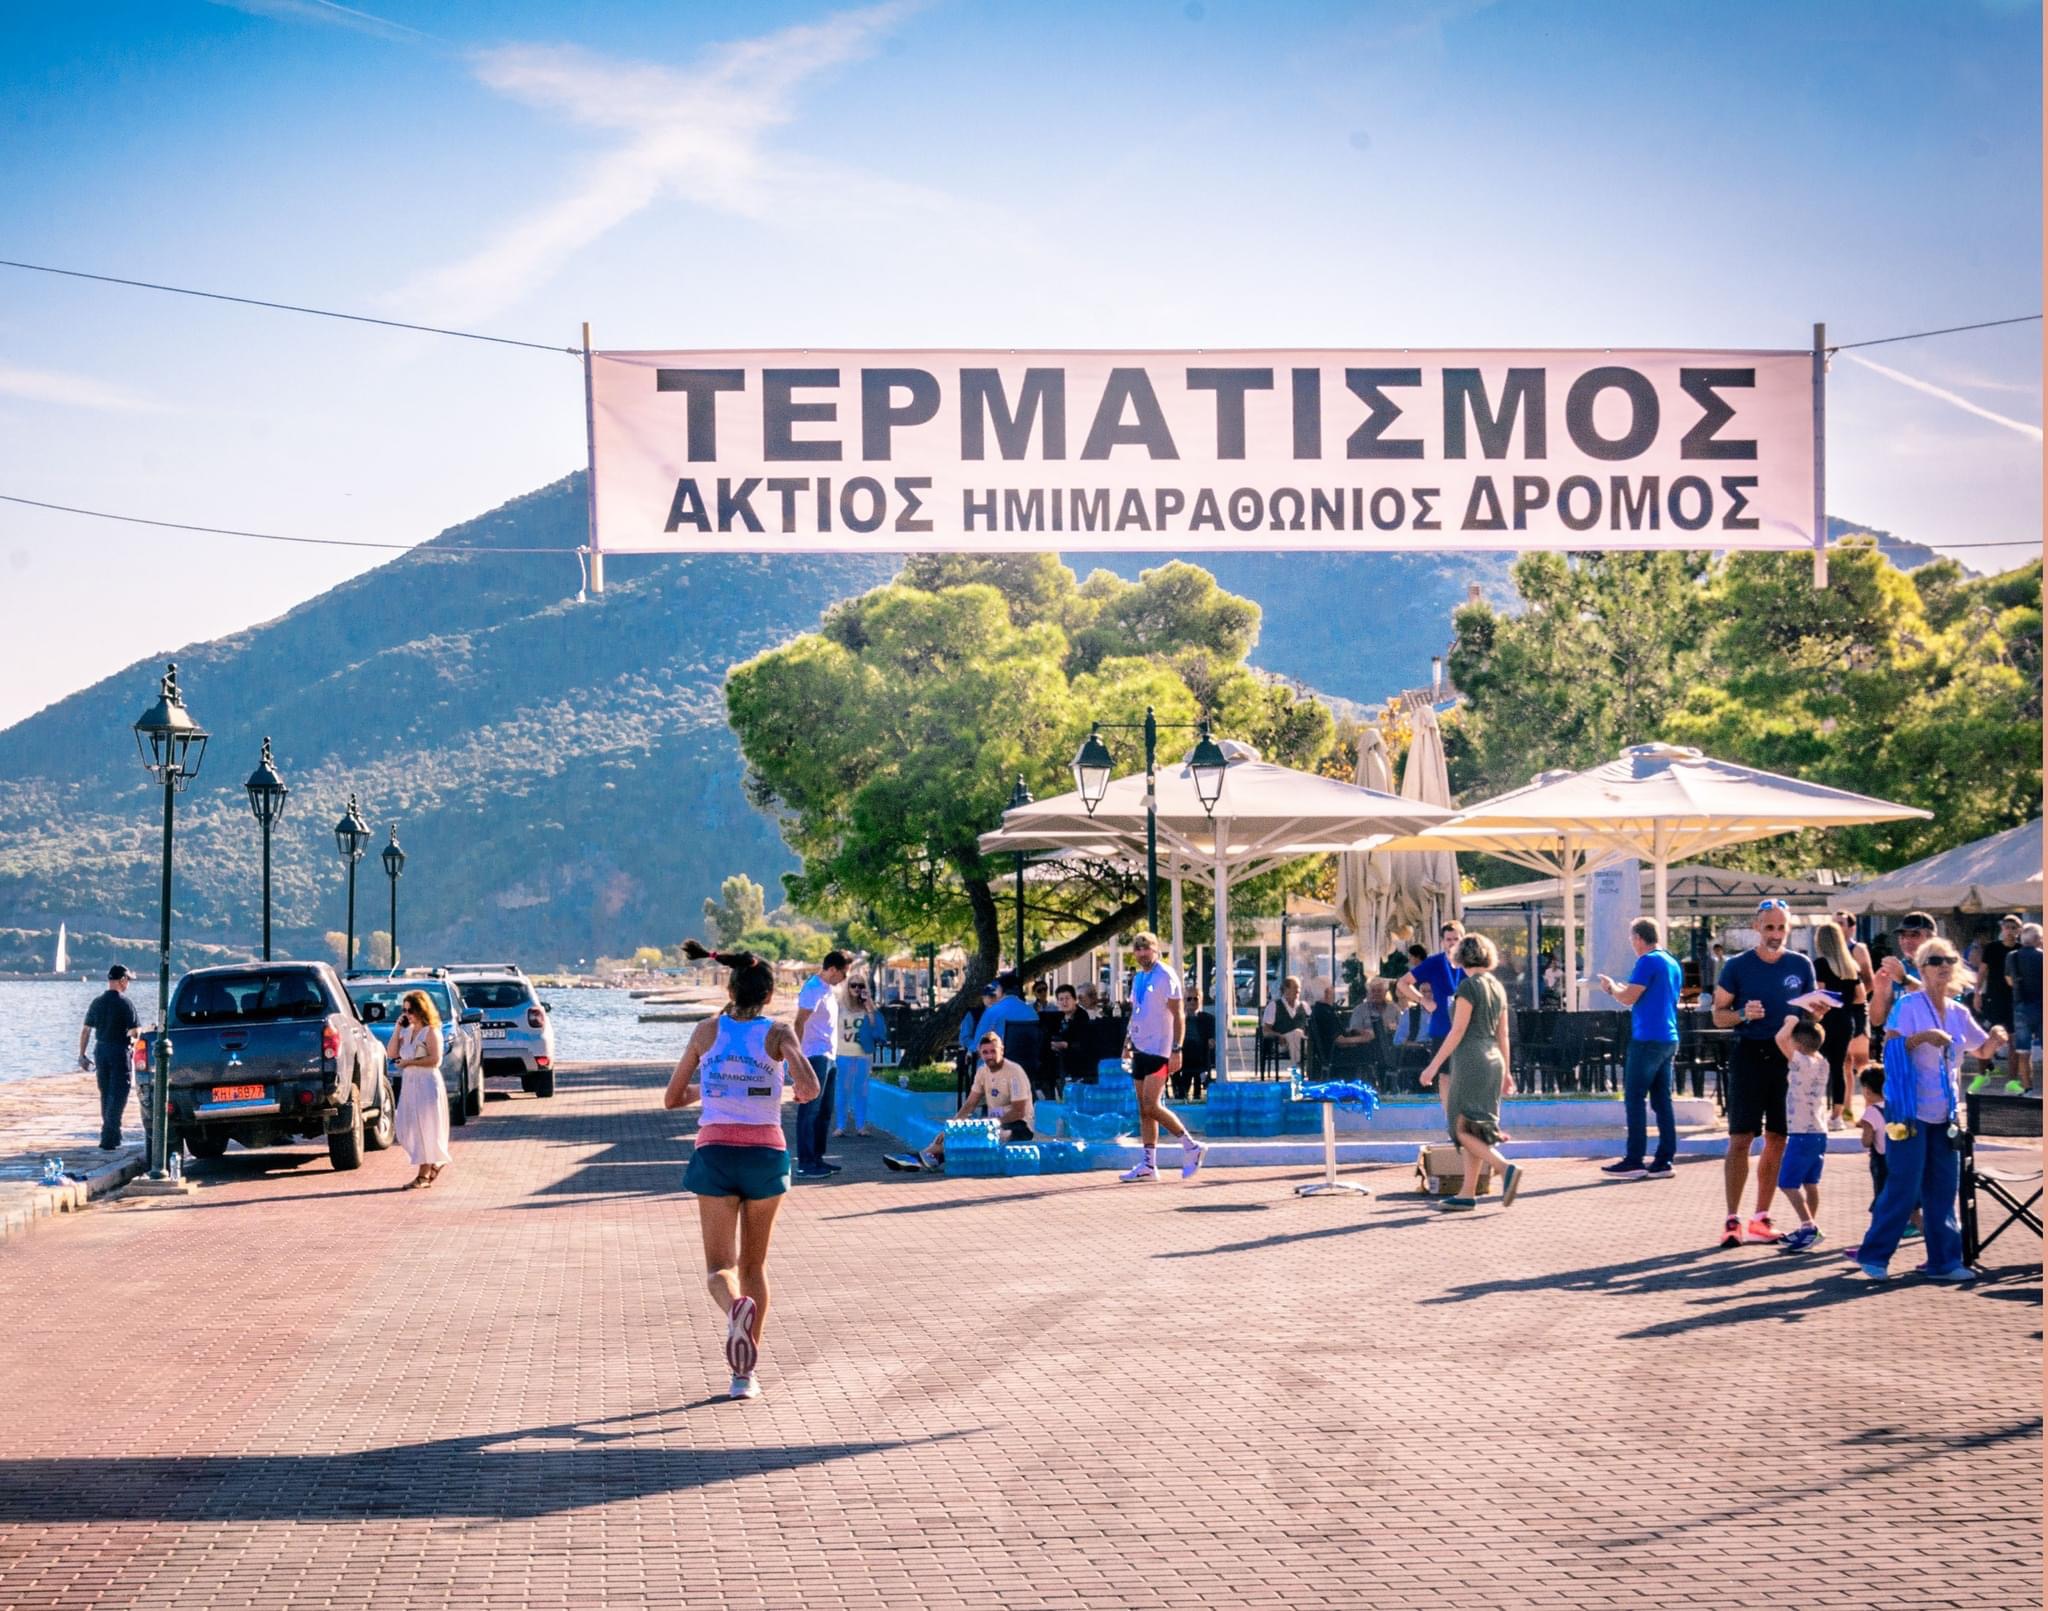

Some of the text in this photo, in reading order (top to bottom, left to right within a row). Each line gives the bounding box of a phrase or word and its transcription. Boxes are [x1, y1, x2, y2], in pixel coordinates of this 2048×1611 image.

[656, 366, 1758, 462] ΤΕΡΜΑΤΙΣΜΟΣ
[663, 475, 1760, 533] ΑΚΤΙΟΣ ΗΜΙΜΑΡΑΘΩΝΙΟΣ ΔΡΟΜΟΣ
